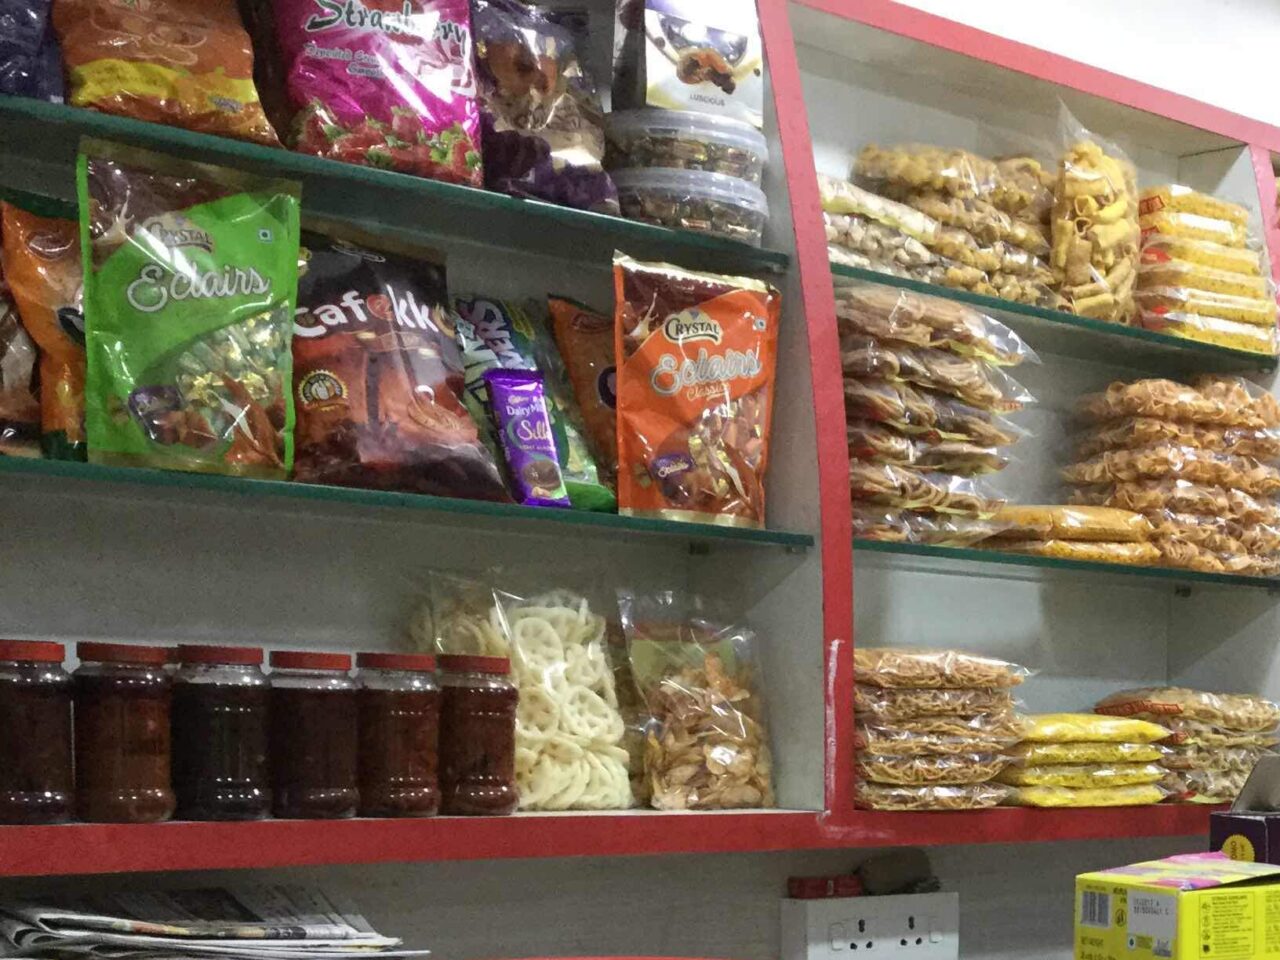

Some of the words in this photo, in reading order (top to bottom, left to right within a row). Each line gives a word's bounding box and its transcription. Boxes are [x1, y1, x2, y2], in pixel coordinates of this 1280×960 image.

[126, 263, 271, 313] Eclairs
[664, 316, 721, 343] CRYSTAL
[651, 347, 761, 396] Eclairs
[505, 405, 531, 417] Dairy
